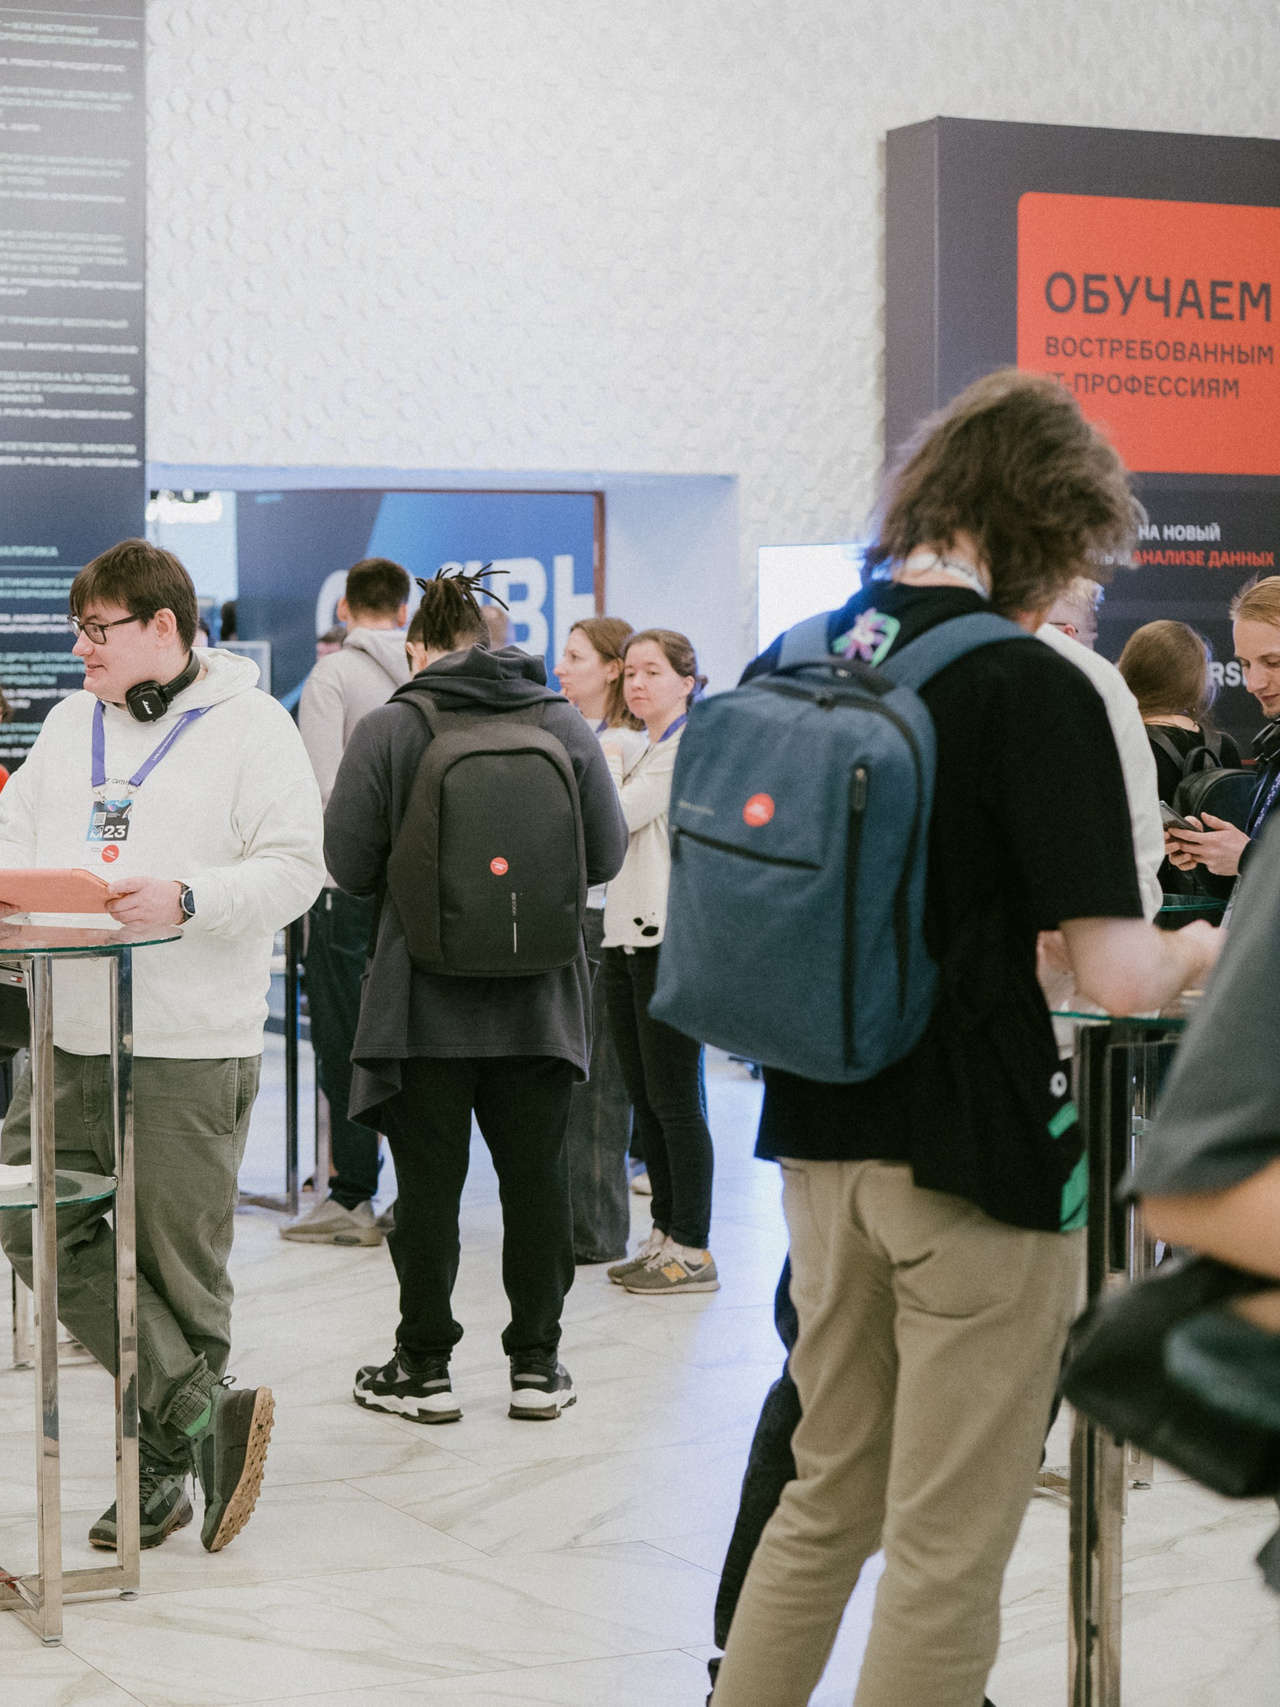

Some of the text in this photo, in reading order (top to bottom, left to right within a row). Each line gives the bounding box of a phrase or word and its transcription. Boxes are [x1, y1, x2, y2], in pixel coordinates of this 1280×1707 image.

[1044, 271, 1272, 322] ОБУЧАЕМ
[1045, 336, 1274, 364] ВОСТРЕБОВАННЫМ
[1138, 522, 1221, 542] НА НОВЫЙ
[1132, 550, 1205, 567] АНАЛИЗЕ
[1208, 551, 1275, 569] ДАННЫХ
